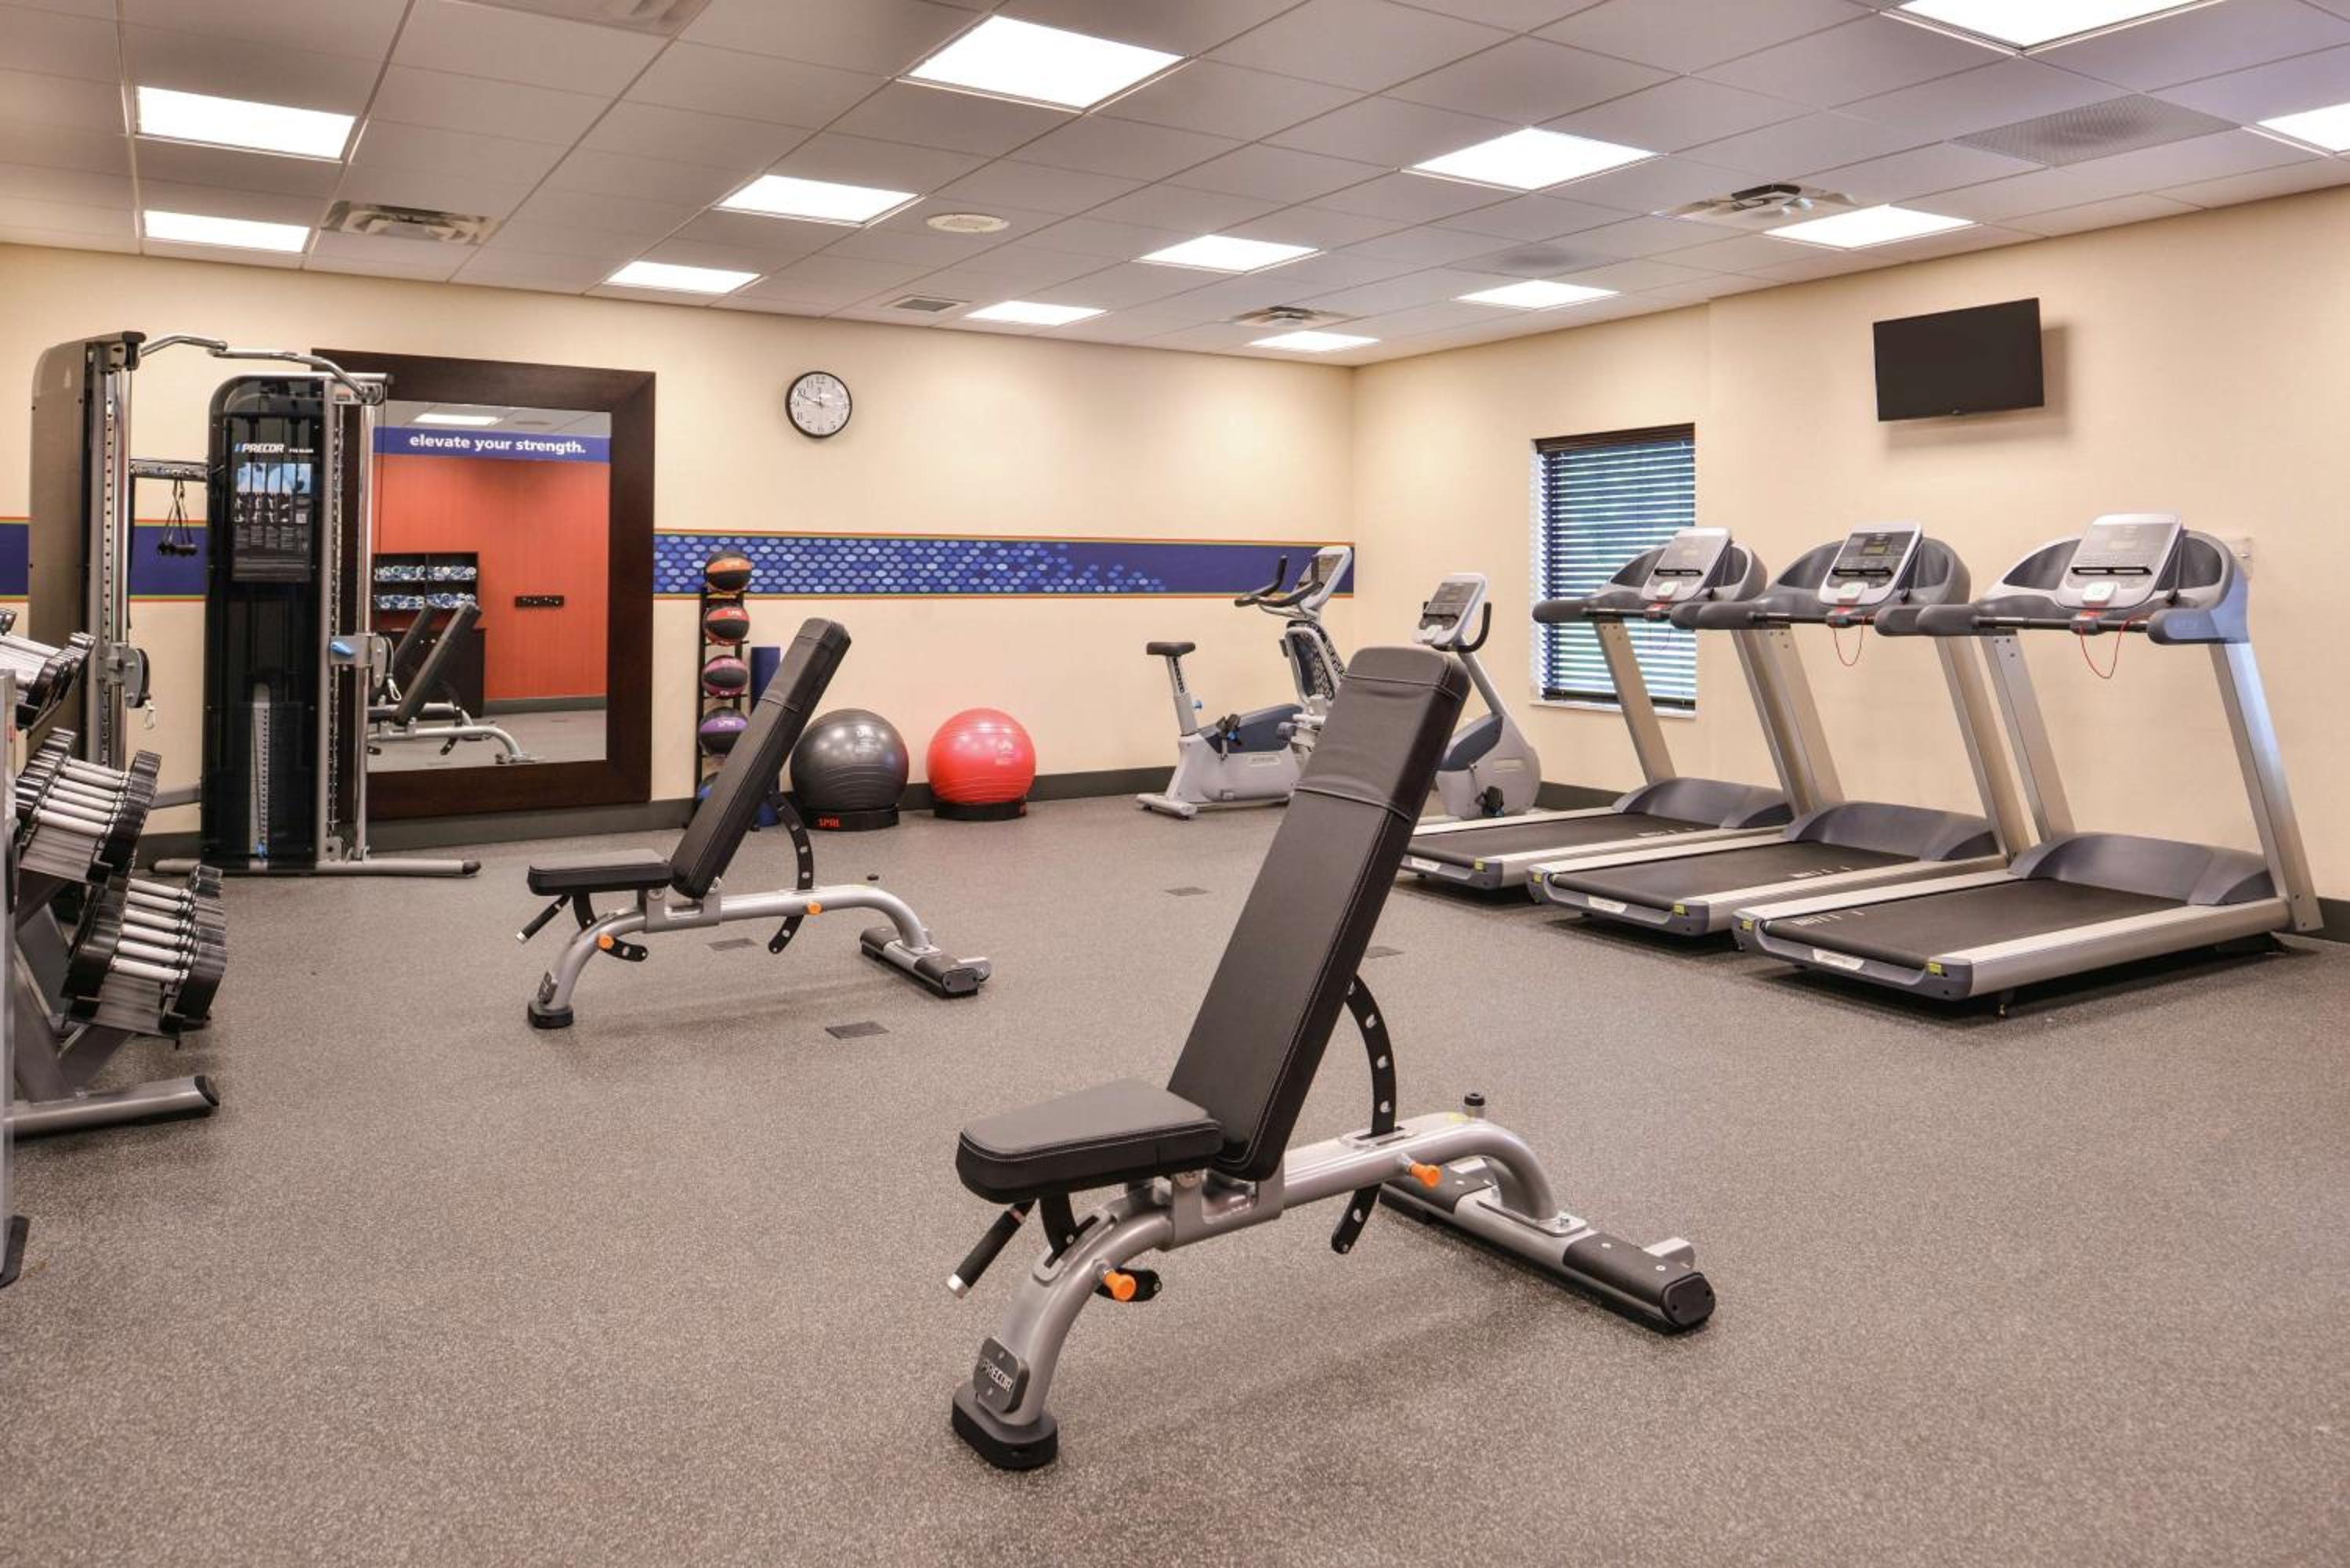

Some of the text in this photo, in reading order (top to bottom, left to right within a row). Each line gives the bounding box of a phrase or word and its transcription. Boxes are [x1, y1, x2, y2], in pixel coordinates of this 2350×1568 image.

[242, 443, 284, 453] PRECOR
[410, 434, 587, 456] elevate your strength.
[983, 1359, 1013, 1392] PRECOR
